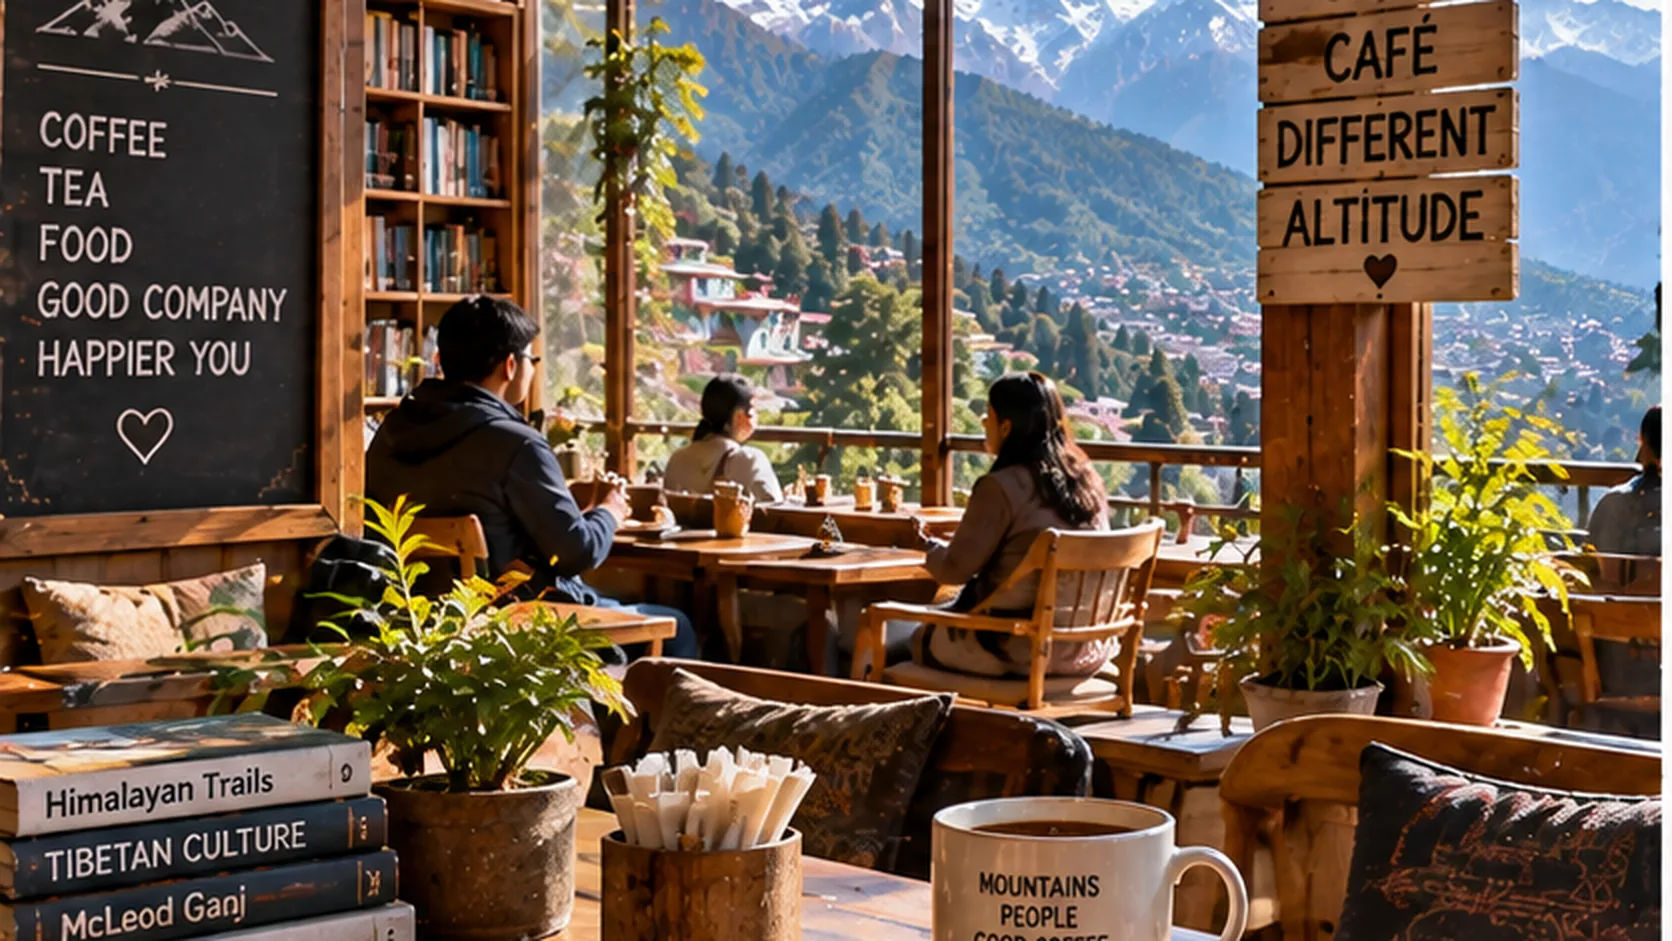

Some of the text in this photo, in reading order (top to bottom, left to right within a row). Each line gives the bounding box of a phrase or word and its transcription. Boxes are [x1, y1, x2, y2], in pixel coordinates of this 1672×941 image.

[1324, 14, 1438, 83] CAFÉ
[39, 111, 167, 159] COFFEE
[1277, 104, 1496, 168] DIFFERENT
[39, 166, 109, 208] TEA
[39, 224, 133, 264] FOOD
[38, 281, 288, 322] GOOD COMPANY
[38, 340, 251, 377] HAPPIER YOU
[46, 767, 274, 819] Himalayan Trails
[44, 820, 307, 882] TIBETAN CULTURE
[979, 871, 1100, 898] MOUNTAINS
[61, 885, 246, 941] McLeod Ganj
[1000, 903, 1078, 929] PEOPLE
